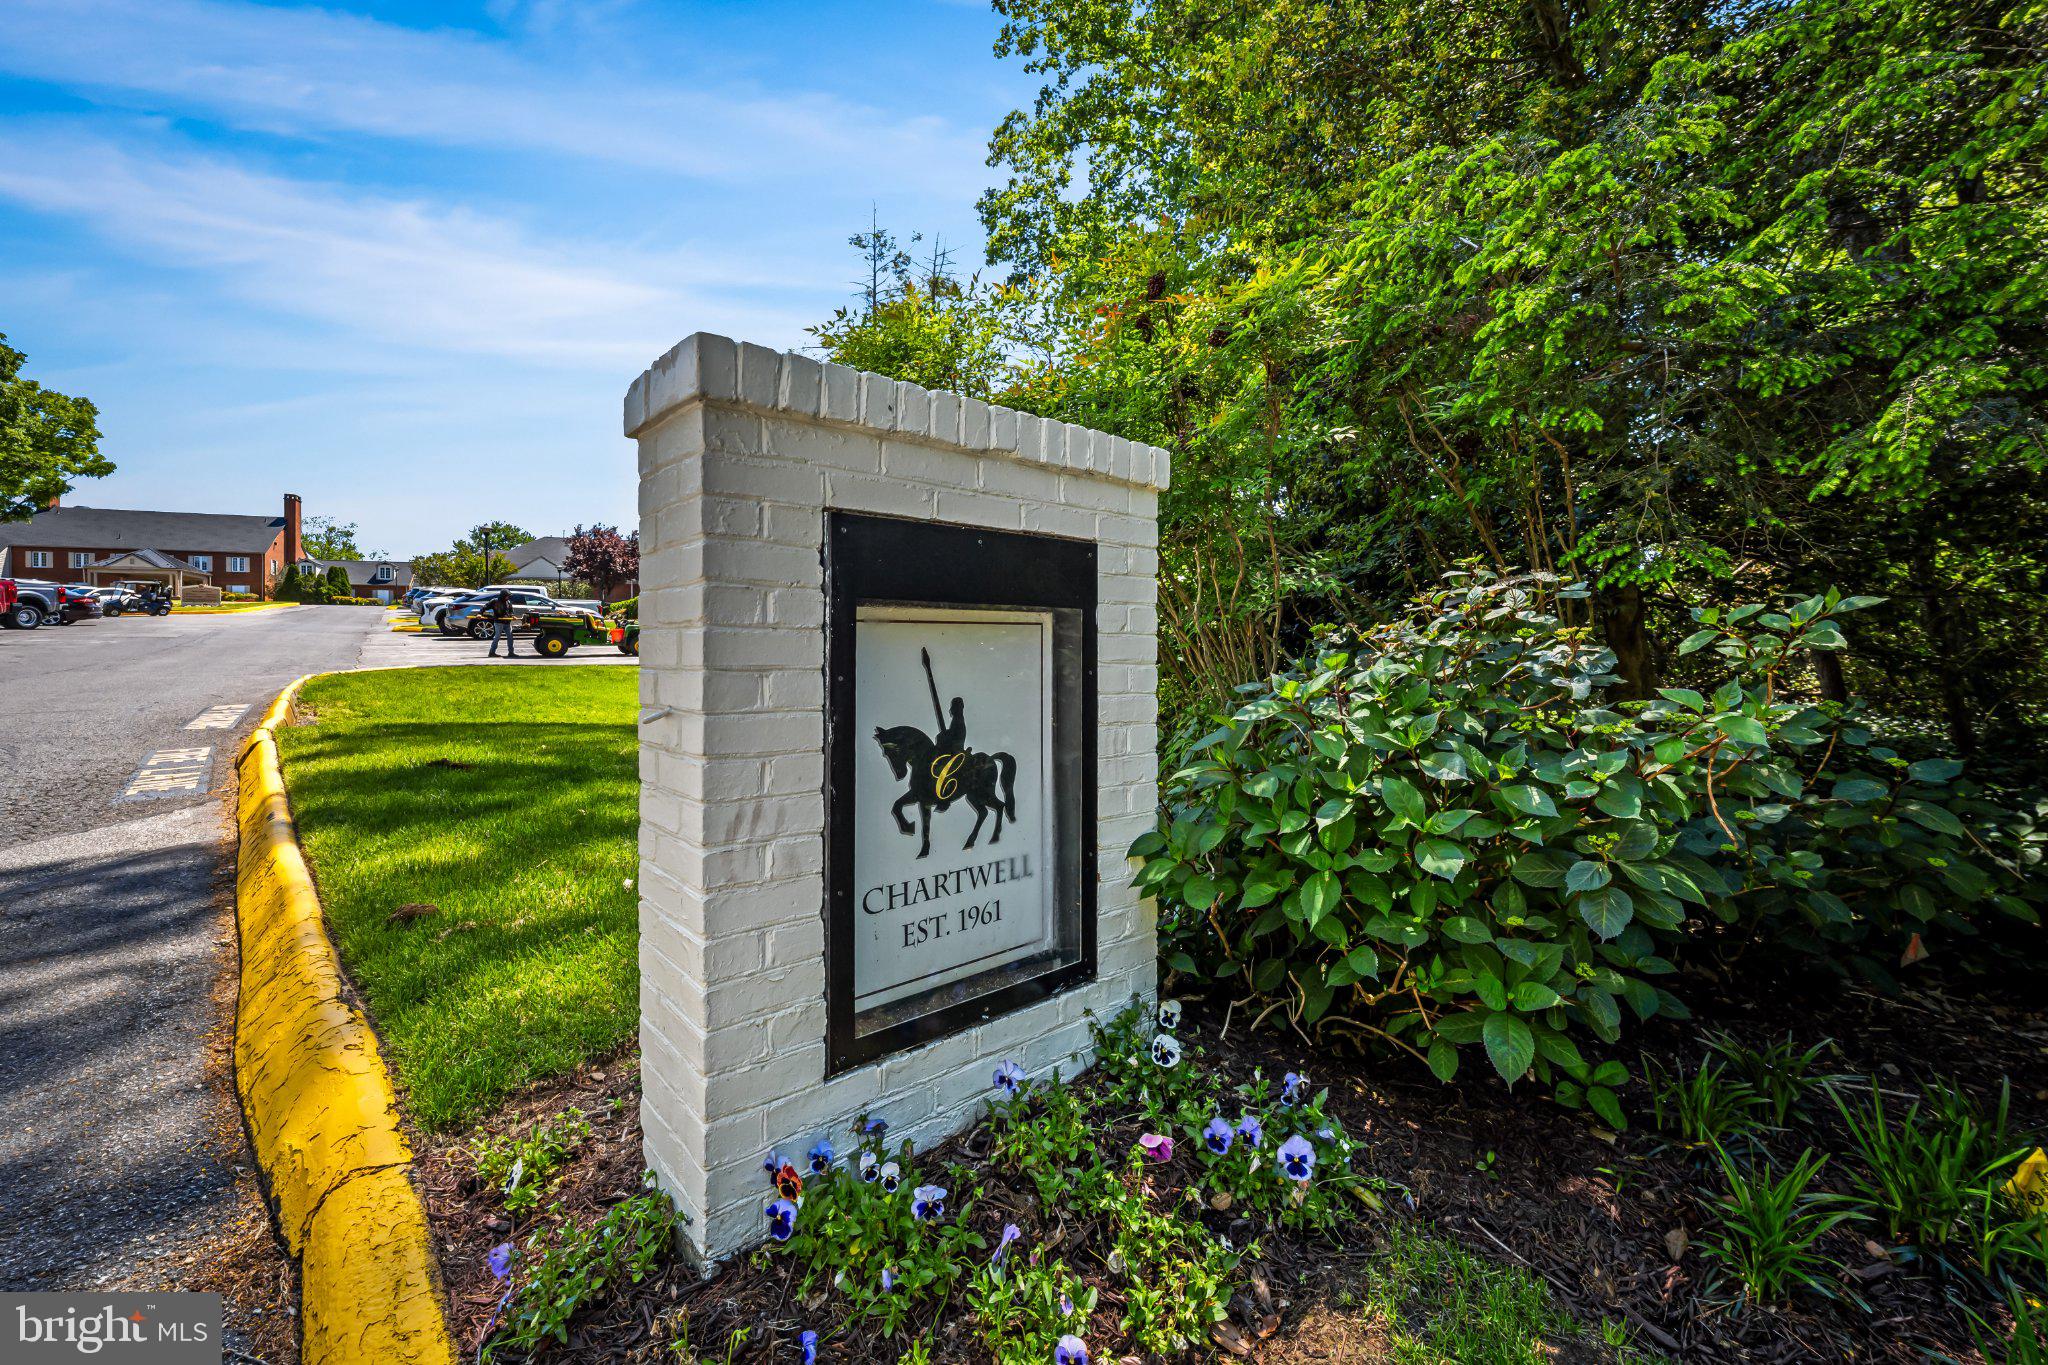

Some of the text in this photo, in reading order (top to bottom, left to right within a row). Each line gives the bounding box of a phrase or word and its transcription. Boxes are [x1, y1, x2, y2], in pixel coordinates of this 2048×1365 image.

[930, 752, 966, 800] C
[862, 854, 1034, 915] CHARTWELL
[902, 899, 1003, 948] EST. 1961
